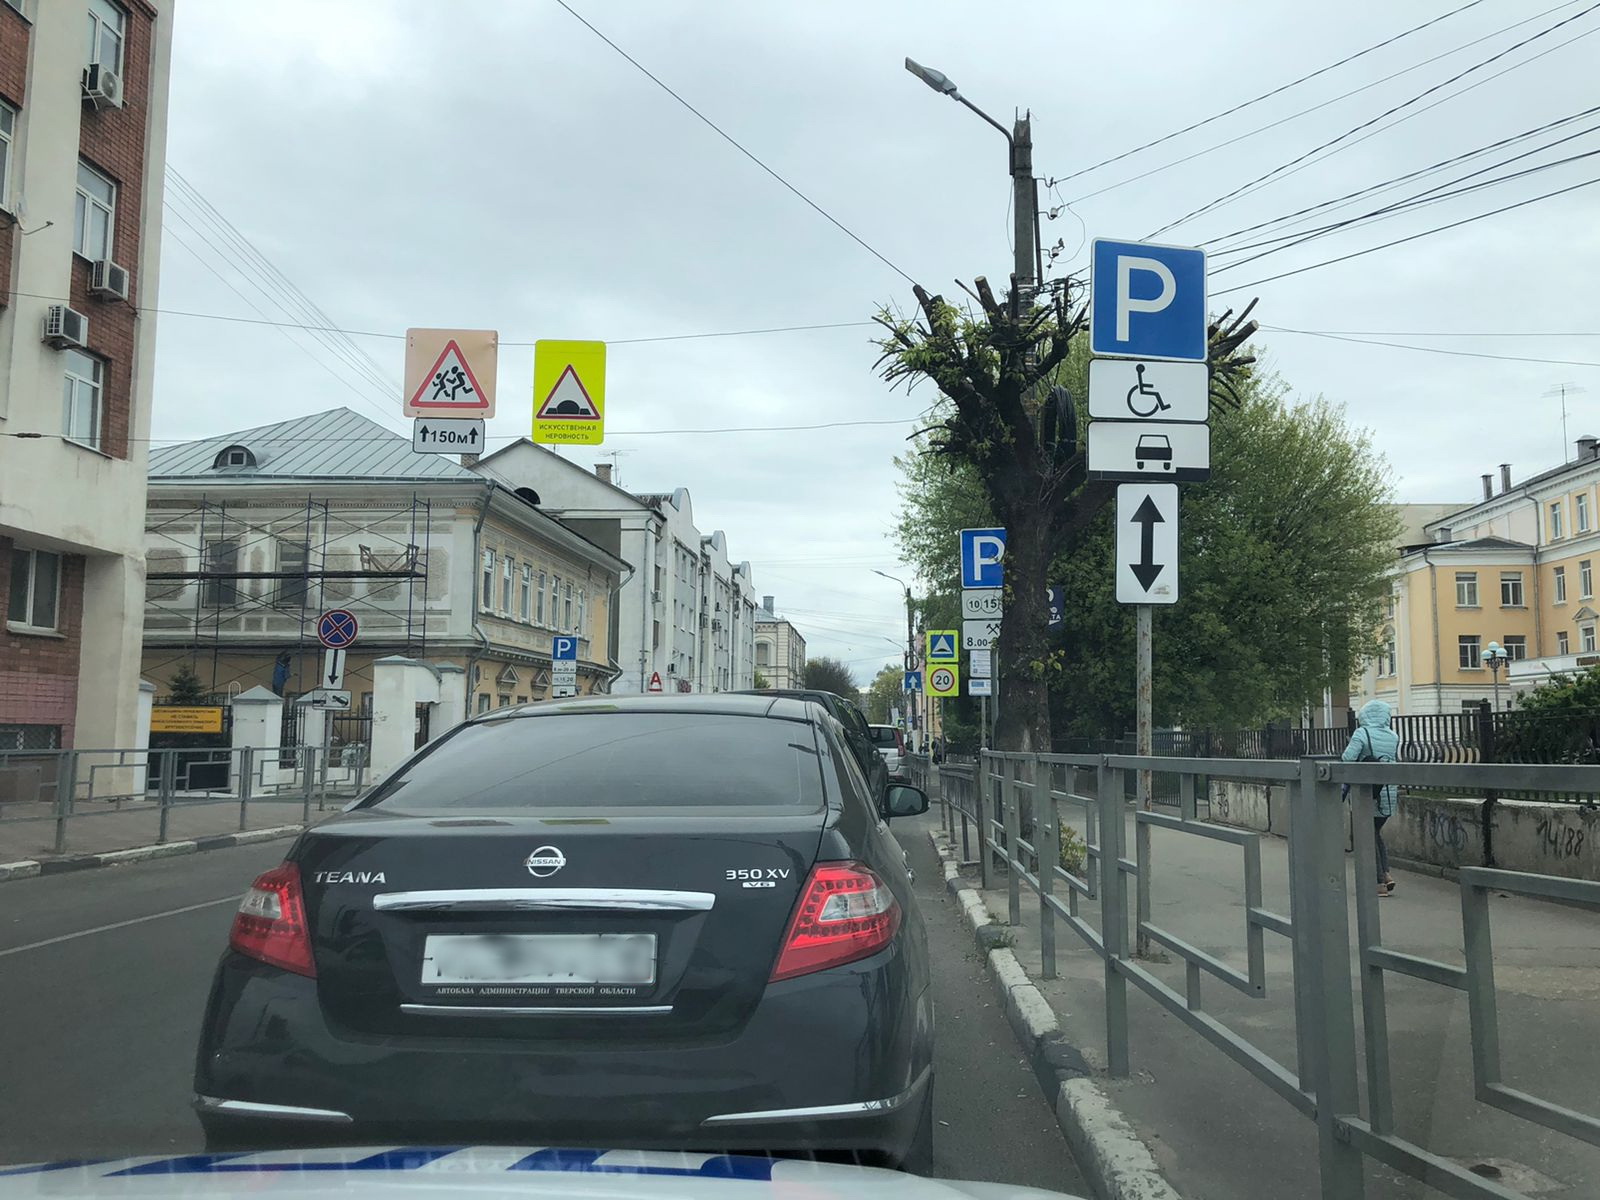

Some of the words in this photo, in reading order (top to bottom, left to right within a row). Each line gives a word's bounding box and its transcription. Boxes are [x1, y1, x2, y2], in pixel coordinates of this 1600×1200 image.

[1116, 255, 1177, 342] P
[538, 424, 597, 432] ИСКУССТВЕННАЯ
[430, 430, 469, 444] 150м
[973, 535, 1005, 581] P
[969, 600, 980, 608] 10
[984, 599, 997, 609] 15
[557, 638, 571, 658] P
[935, 675, 950, 685] 20
[528, 858, 562, 866] NISSAN
[314, 871, 387, 884] TEANA
[725, 869, 763, 880] 350
[766, 868, 790, 879] XV
[435, 987, 475, 995] АВТОБАЗА
[478, 987, 550, 995] АДМИНИСТРАЦИИ
[555, 986, 595, 995] ТВЕРСКОЙ
[599, 987, 636, 995] ОБЛАСТИ
